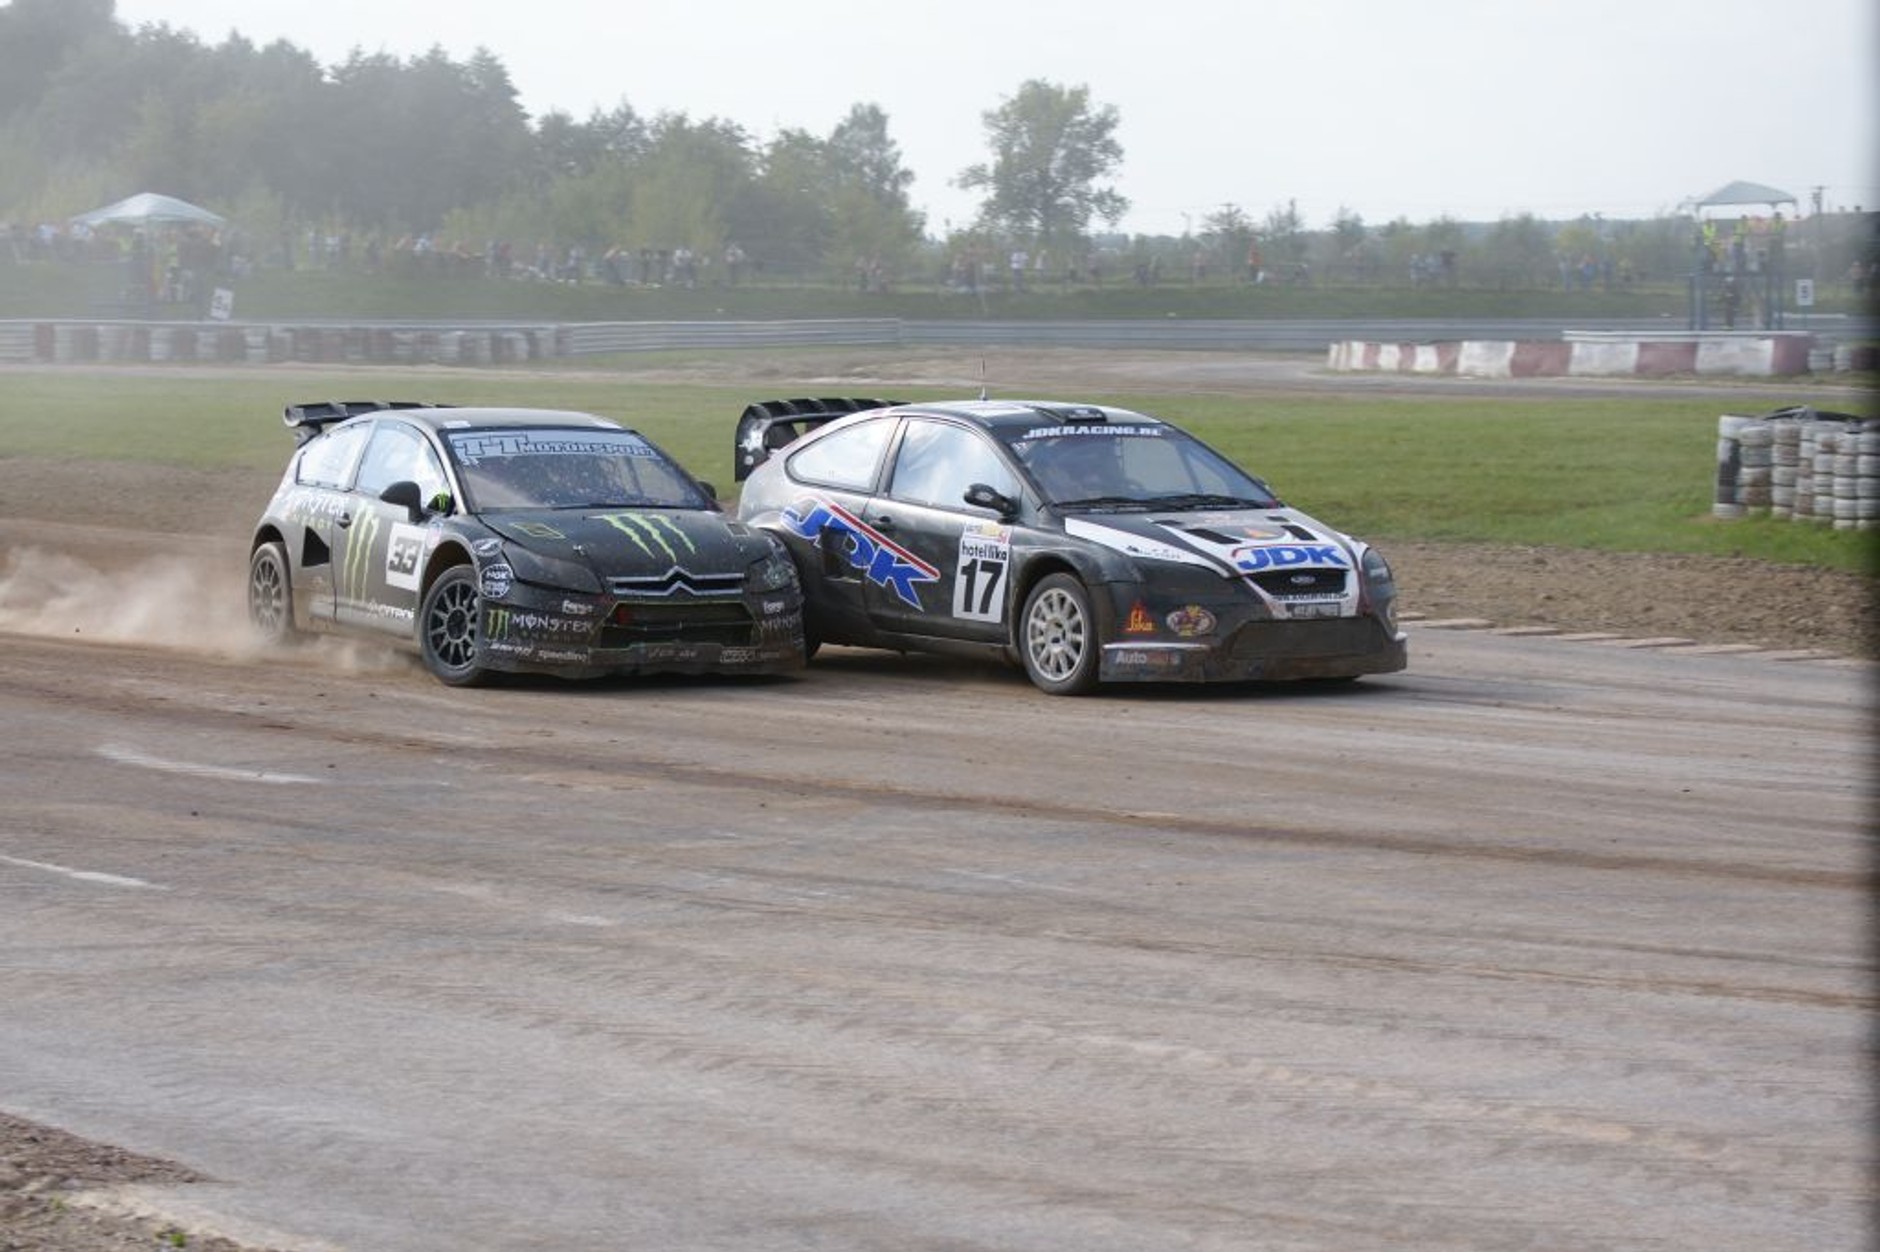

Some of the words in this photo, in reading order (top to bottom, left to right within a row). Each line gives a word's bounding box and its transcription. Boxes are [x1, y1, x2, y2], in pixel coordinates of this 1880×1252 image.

[1237, 546, 1348, 570] JDK
[960, 558, 1003, 614] 17
[512, 612, 592, 633] MONSTER
